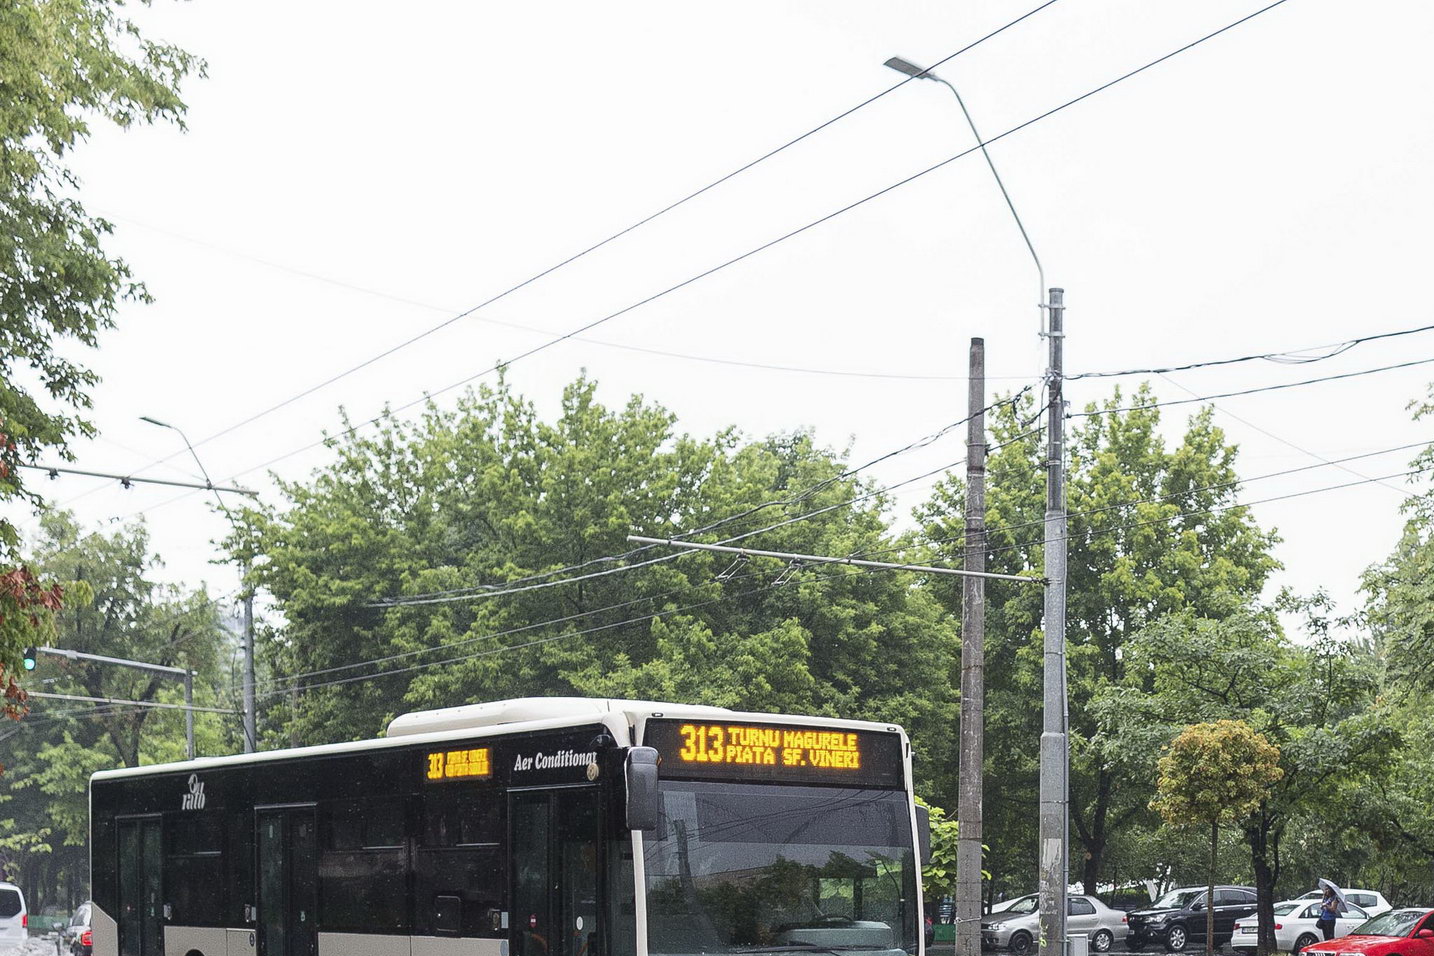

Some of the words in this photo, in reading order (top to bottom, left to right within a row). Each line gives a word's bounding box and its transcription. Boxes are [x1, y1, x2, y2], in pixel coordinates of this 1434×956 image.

[680, 725, 724, 762] 313
[727, 727, 780, 747] TURNU
[783, 730, 858, 751] MAGURELE
[427, 752, 444, 779] 313
[514, 754, 534, 771] Aer
[726, 745, 776, 765] PIATA
[783, 748, 806, 766] SF.
[809, 751, 860, 768] VINERI
